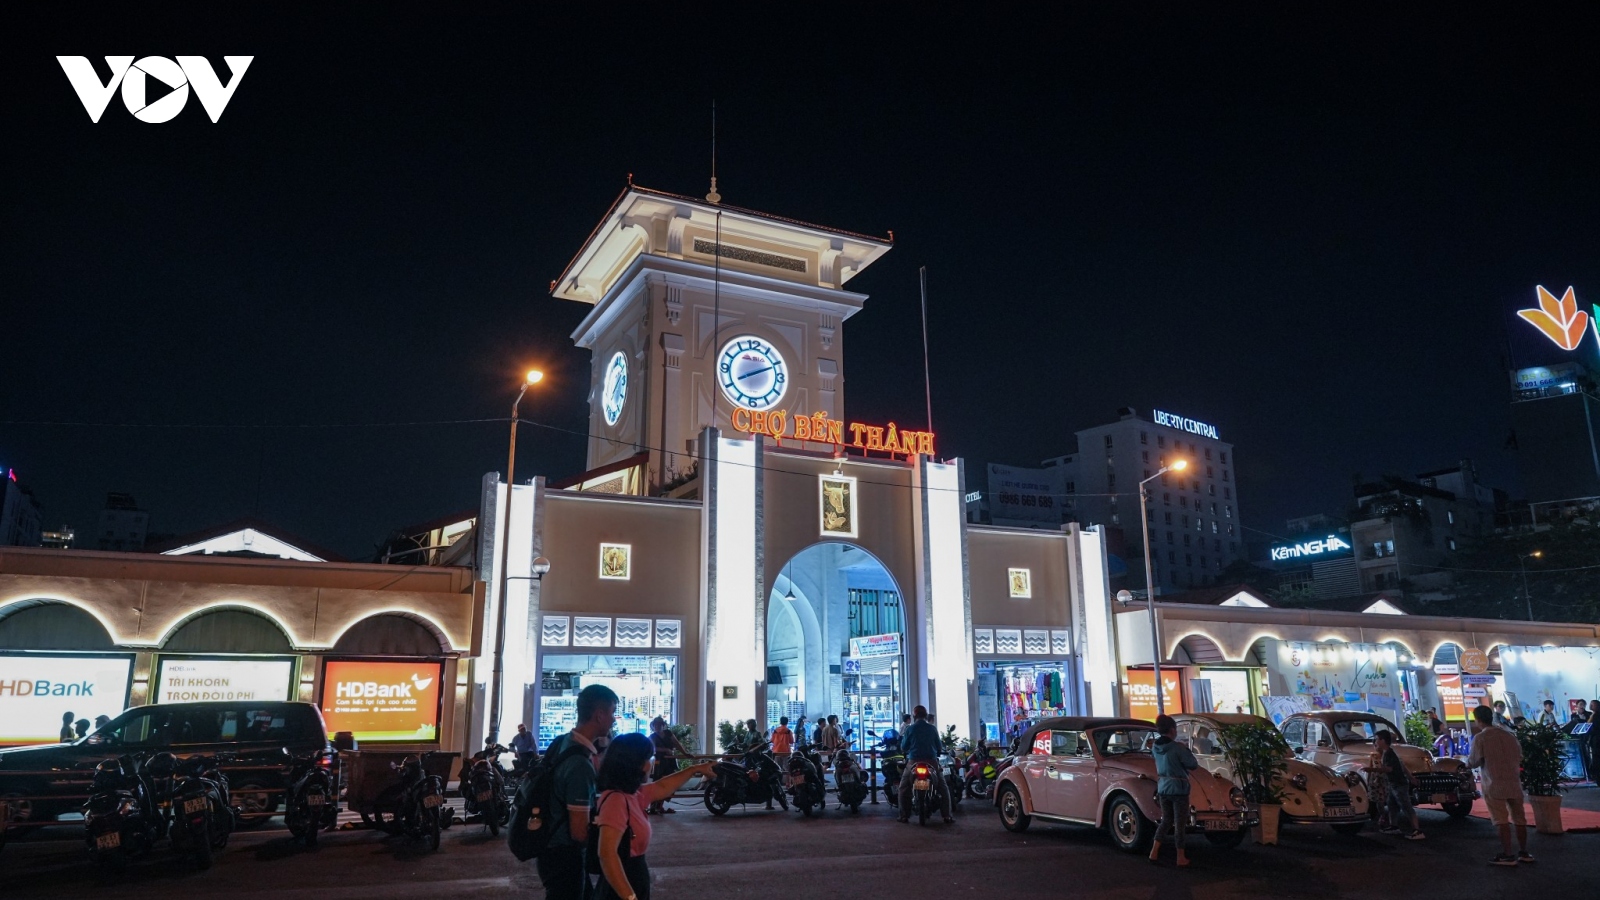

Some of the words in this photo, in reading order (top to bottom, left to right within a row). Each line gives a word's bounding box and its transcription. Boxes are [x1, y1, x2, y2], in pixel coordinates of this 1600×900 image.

[746, 339, 761, 351] 12
[720, 362, 730, 374] 9
[776, 372, 786, 384] 3
[748, 397, 758, 408] 6
[1153, 409, 1184, 430] LIBERTY
[1184, 417, 1219, 440] CENTRAL
[731, 408, 787, 441] CHỢ
[794, 411, 844, 444] BẾN
[849, 422, 935, 456] THÀNH
[965, 490, 982, 504] OTEL
[0, 679, 94, 697] HDBank
[336, 681, 412, 698] HDBank
[1129, 684, 1168, 696] HDBak
